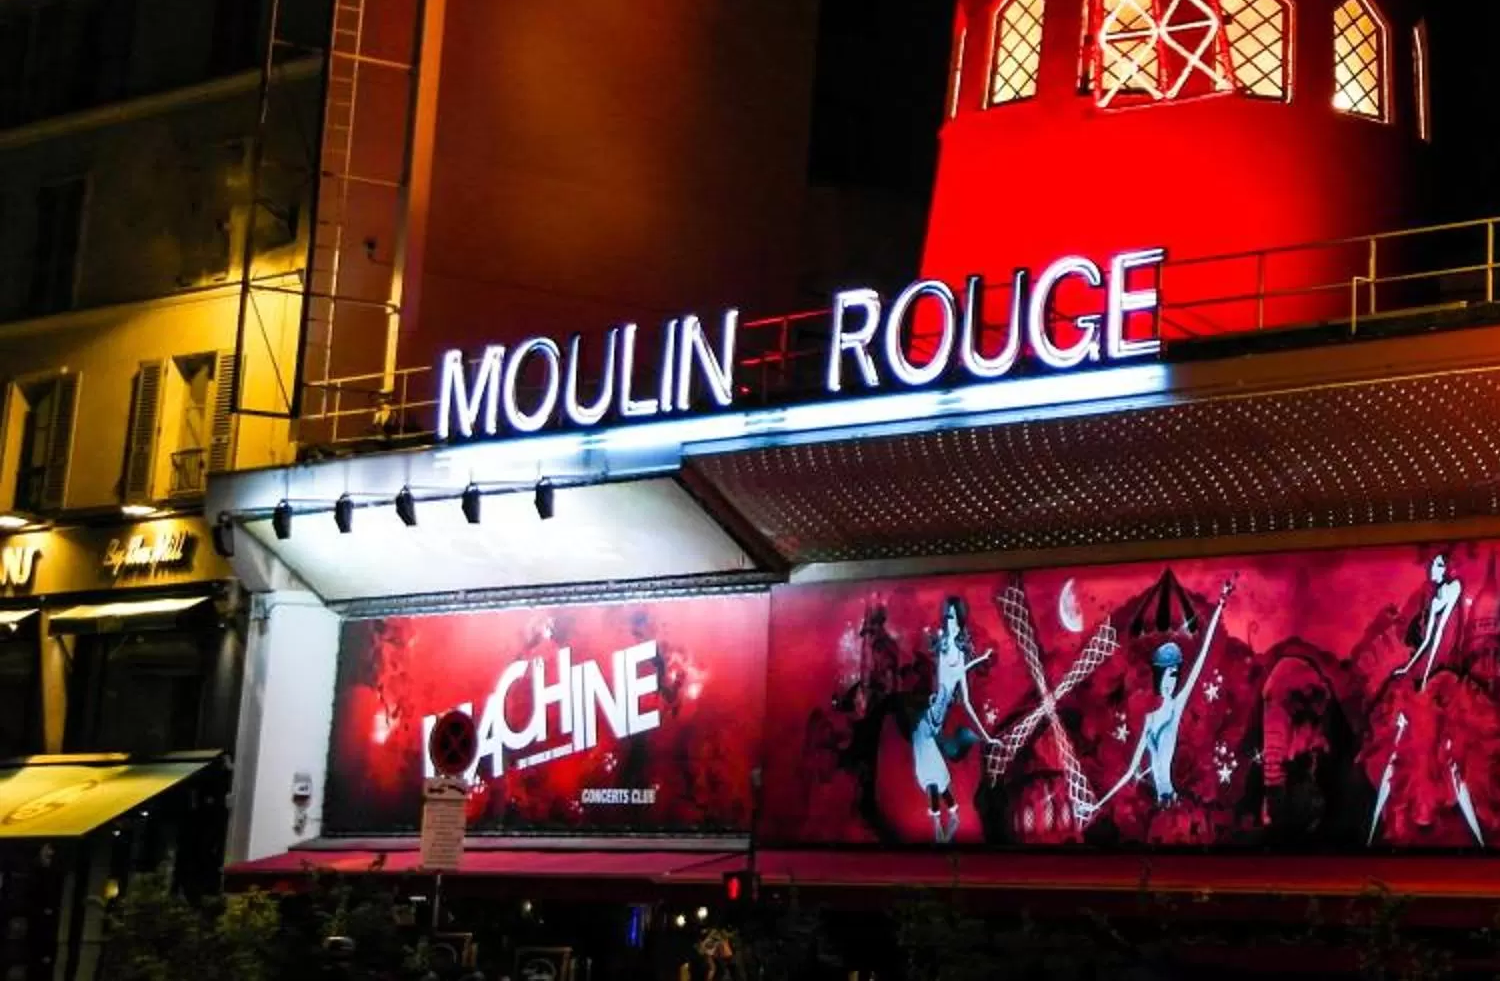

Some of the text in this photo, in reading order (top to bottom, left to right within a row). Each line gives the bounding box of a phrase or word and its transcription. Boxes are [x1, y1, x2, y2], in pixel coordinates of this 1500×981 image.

[436, 247, 1166, 439] MOULIN ROUGE
[581, 788, 629, 804] CONCERTS
